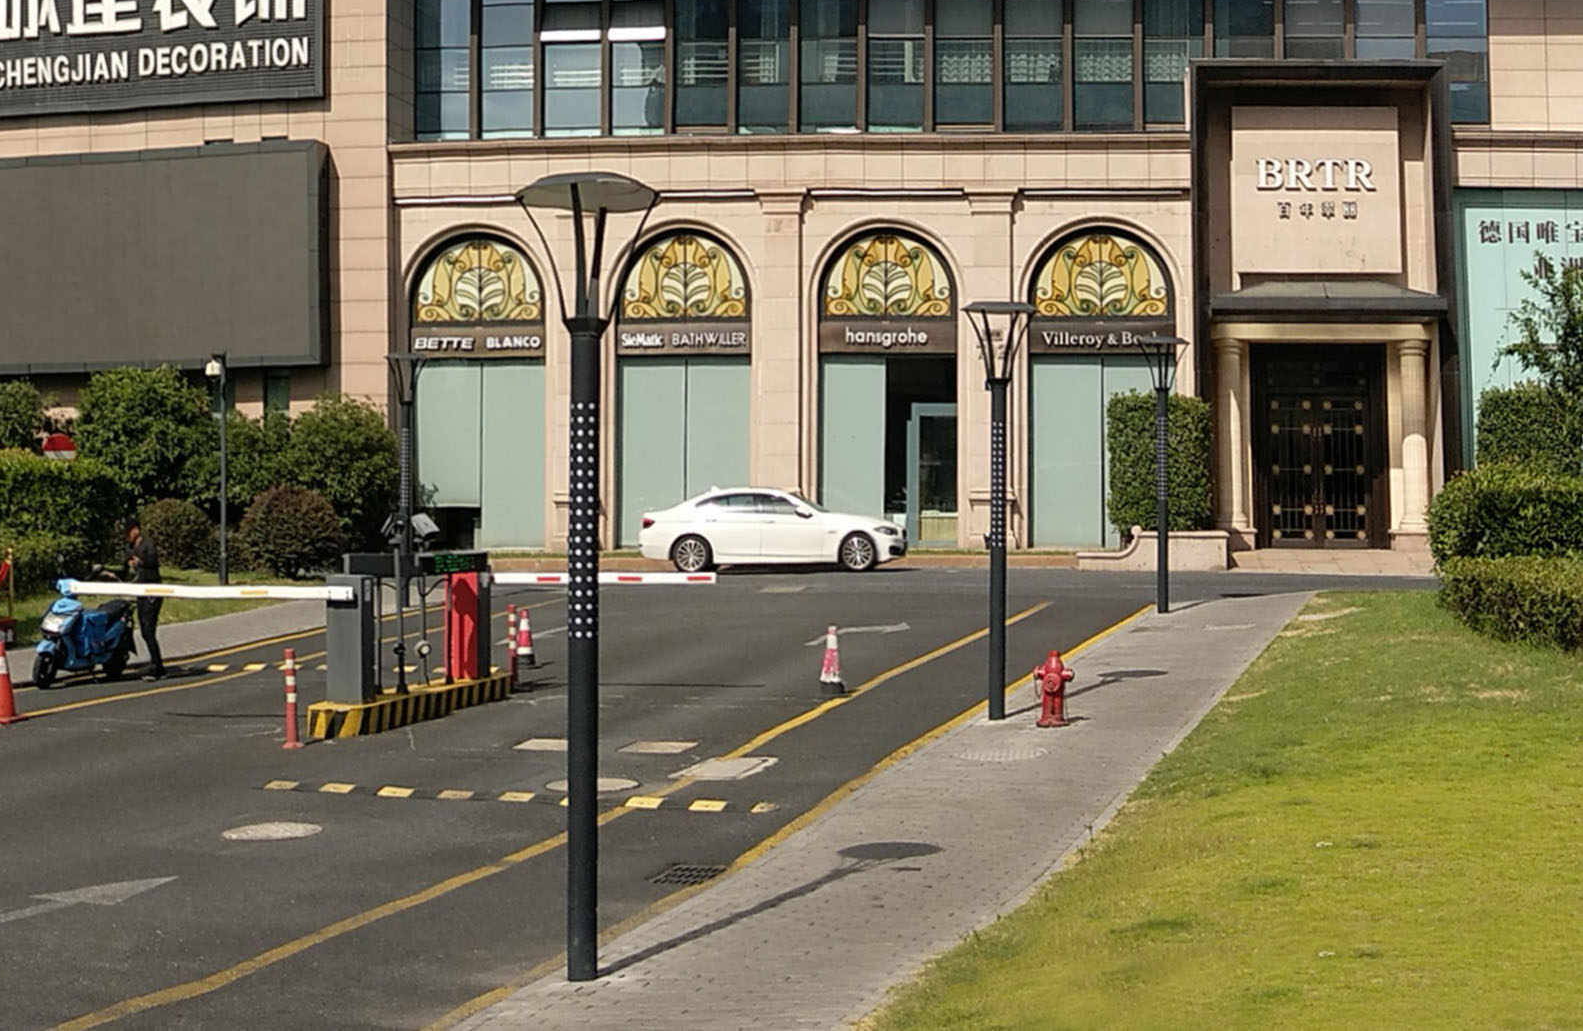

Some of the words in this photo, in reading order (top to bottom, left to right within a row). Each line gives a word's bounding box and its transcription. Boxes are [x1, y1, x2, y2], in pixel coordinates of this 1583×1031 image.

[138, 36, 309, 78] DECORATION
[1256, 159, 1377, 192] BRTR
[414, 336, 474, 351] BETTE
[485, 335, 542, 350] BLANCO
[620, 331, 665, 348] SieMatic
[845, 327, 928, 347] hansgrohe
[1042, 330, 1105, 350] Villeroy
[1107, 333, 1118, 346] &
